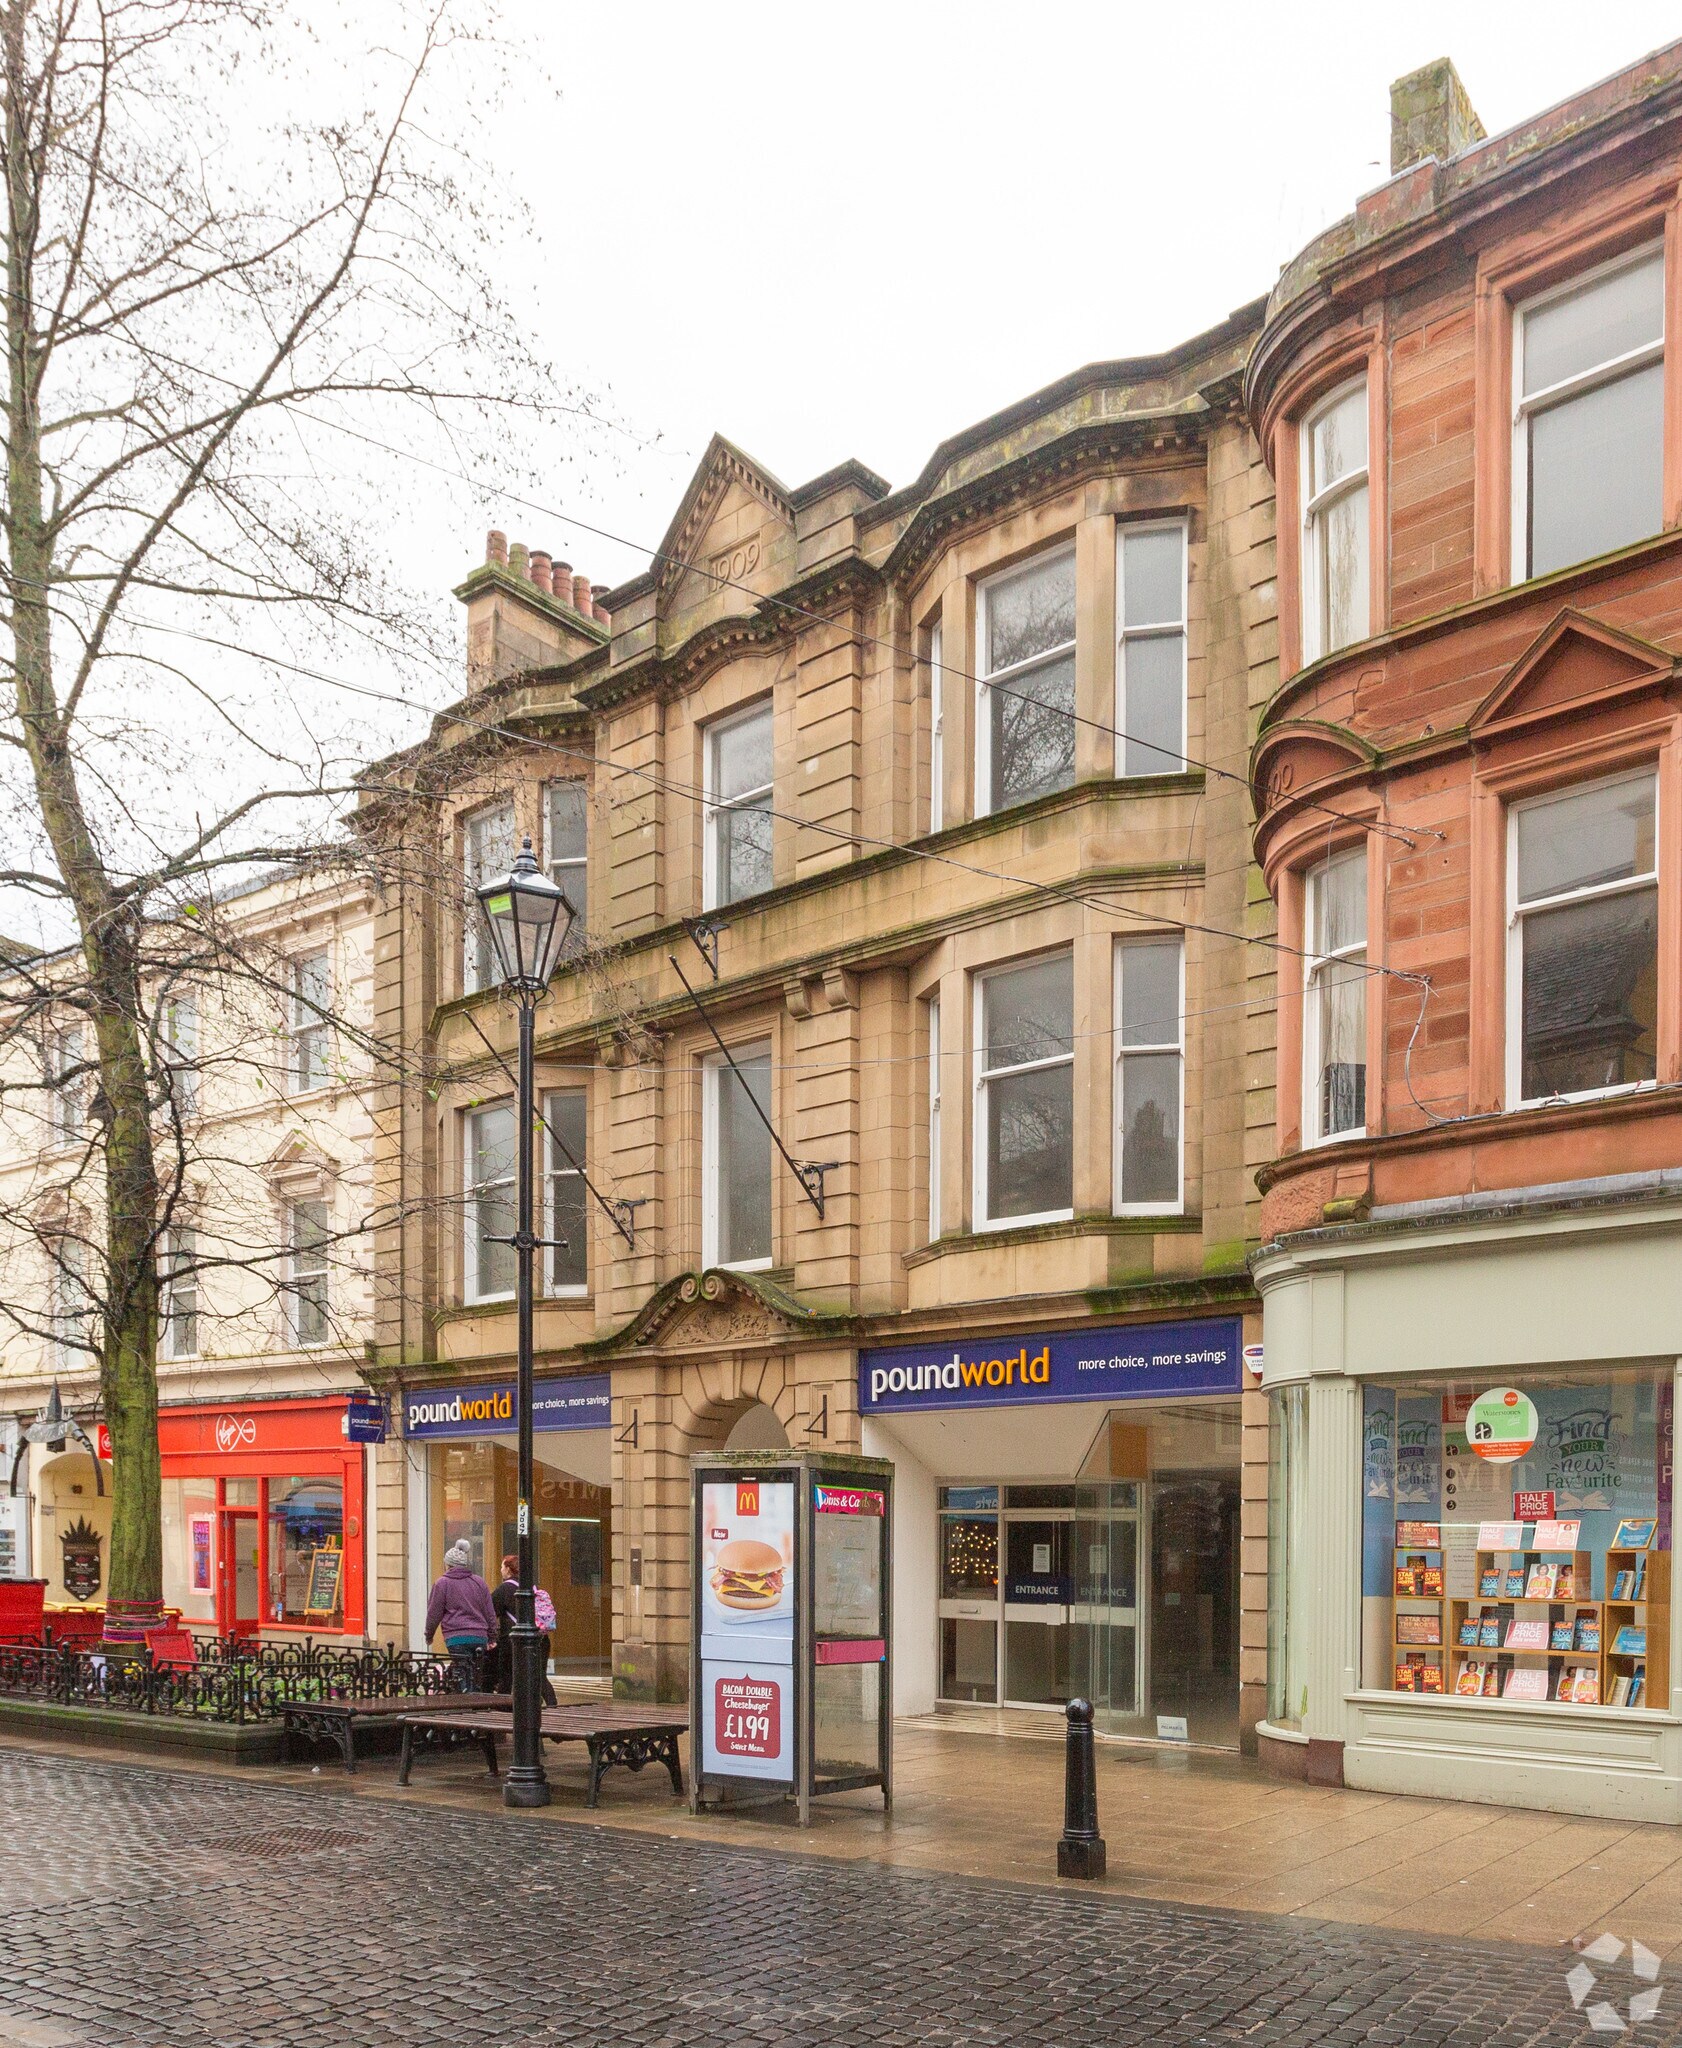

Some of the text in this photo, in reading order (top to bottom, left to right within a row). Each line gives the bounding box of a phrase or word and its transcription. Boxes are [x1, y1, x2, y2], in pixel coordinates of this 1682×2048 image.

[710, 541, 760, 593] 1909
[1078, 1349, 1227, 1370] more choice, more savings
[871, 1347, 1050, 1402] poundworld
[545, 1397, 567, 1410] choice,
[568, 1399, 585, 1407] more
[586, 1395, 609, 1407] savings
[410, 1391, 512, 1430] poundworld
[1482, 1409, 1521, 1417] Waterstones
[1545, 1408, 1623, 1448] Find
[1565, 1442, 1598, 1454] YOUR
[1561, 1454, 1609, 1473] new
[840, 1495, 848, 1507] &
[1519, 1493, 1548, 1502] HALF
[1519, 1502, 1548, 1511] PRICE
[194, 1523, 209, 1534] SAVE
[713, 1530, 727, 1539] New
[1015, 1585, 1059, 1595] ENTRANCE
[1080, 1587, 1127, 1598] ENTRANCE
[1514, 1622, 1544, 1630] HALF
[1513, 1630, 1542, 1638] PRICE
[1514, 1672, 1543, 1680] HALF
[1511, 1680, 1541, 1688] PRICE
[722, 1684, 773, 1697] BACON DOUBLE
[724, 1698, 771, 1715] Cheeseburger
[723, 1713, 770, 1741] £1.99
[730, 1741, 765, 1753] Saver Menu
